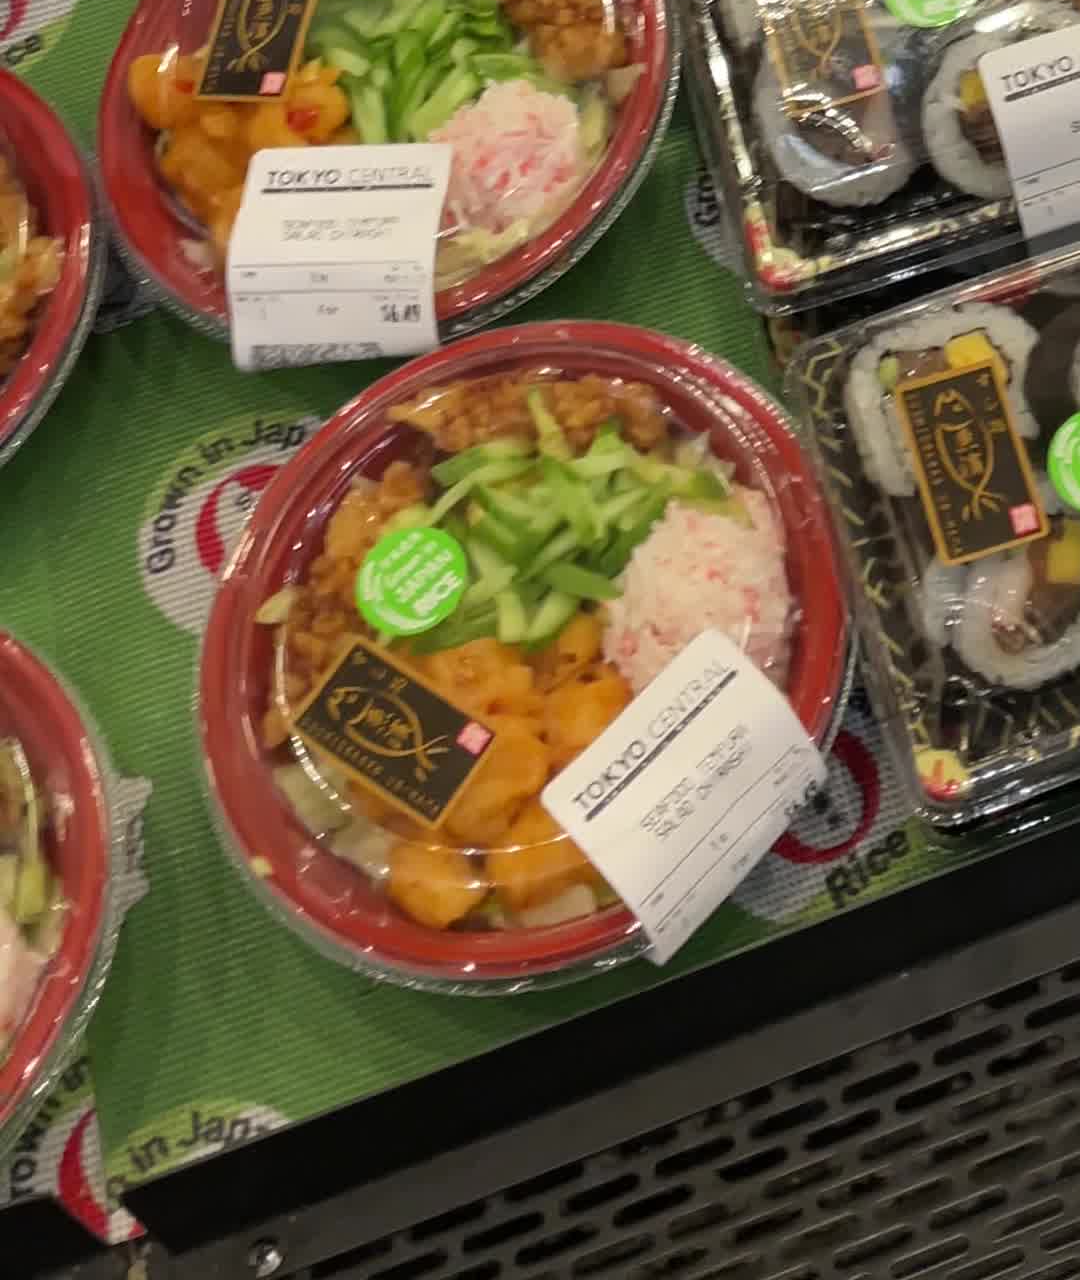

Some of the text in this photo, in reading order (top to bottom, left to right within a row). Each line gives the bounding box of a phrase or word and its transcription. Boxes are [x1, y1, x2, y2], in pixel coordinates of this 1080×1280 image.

[999, 56, 1074, 89] TOKYO
[267, 165, 433, 188] TOKYO CENTRAL
[146, 418, 306, 575] Grown in Jap
[571, 660, 730, 813] TOKYO CENTRAL
[824, 826, 910, 905] Rice
[127, 1134, 169, 1174] in
